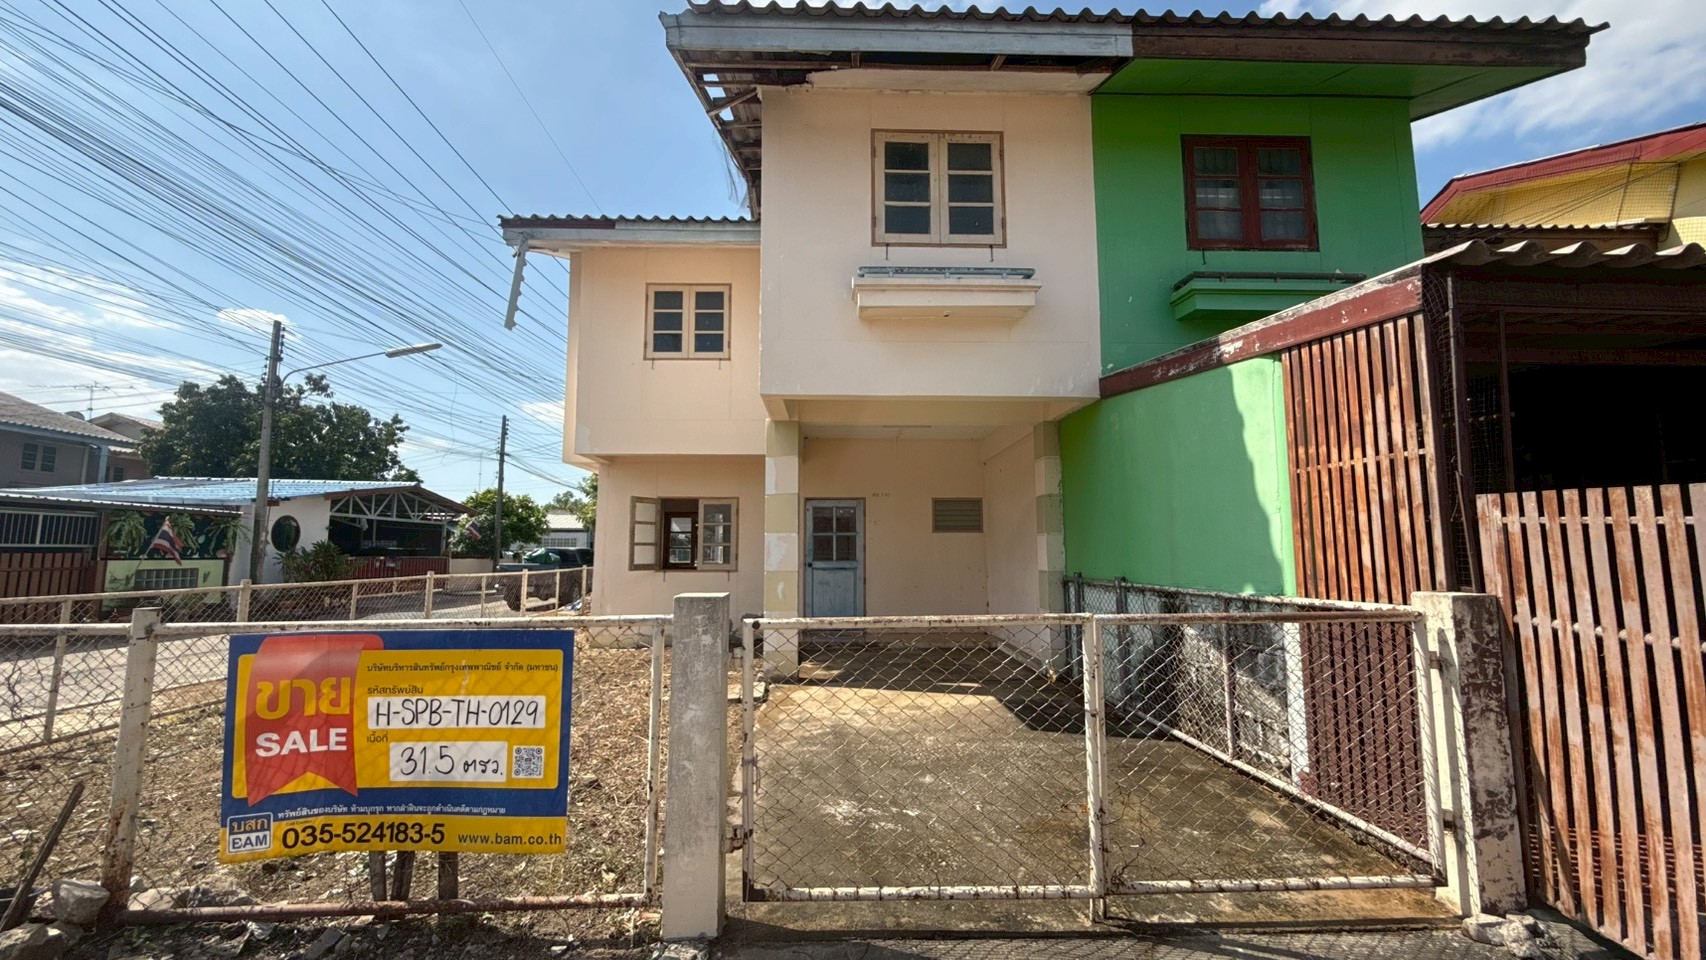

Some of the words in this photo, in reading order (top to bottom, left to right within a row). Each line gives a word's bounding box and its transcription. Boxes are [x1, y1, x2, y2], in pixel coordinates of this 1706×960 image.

[505, 663, 523, 671] จำกัด
[526, 664, 558, 672] (มหาชน)
[256, 677, 351, 719] ขาย
[367, 684, 424, 695] รหัสทรัพย์สิน
[376, 698, 539, 727] H-SPB-TH-0129
[255, 727, 348, 757] SALE
[366, 731, 388, 743] เนื้อที่
[400, 745, 455, 776] 31.5
[277, 804, 348, 819] ทรัพย์สินของบริษัท
[350, 803, 384, 815] ห้ามบุกรุก
[232, 818, 268, 833] บสก
[232, 834, 268, 850] BAM
[282, 822, 445, 849] 035-524183-5
[457, 827, 562, 846] www.bam.co.th
